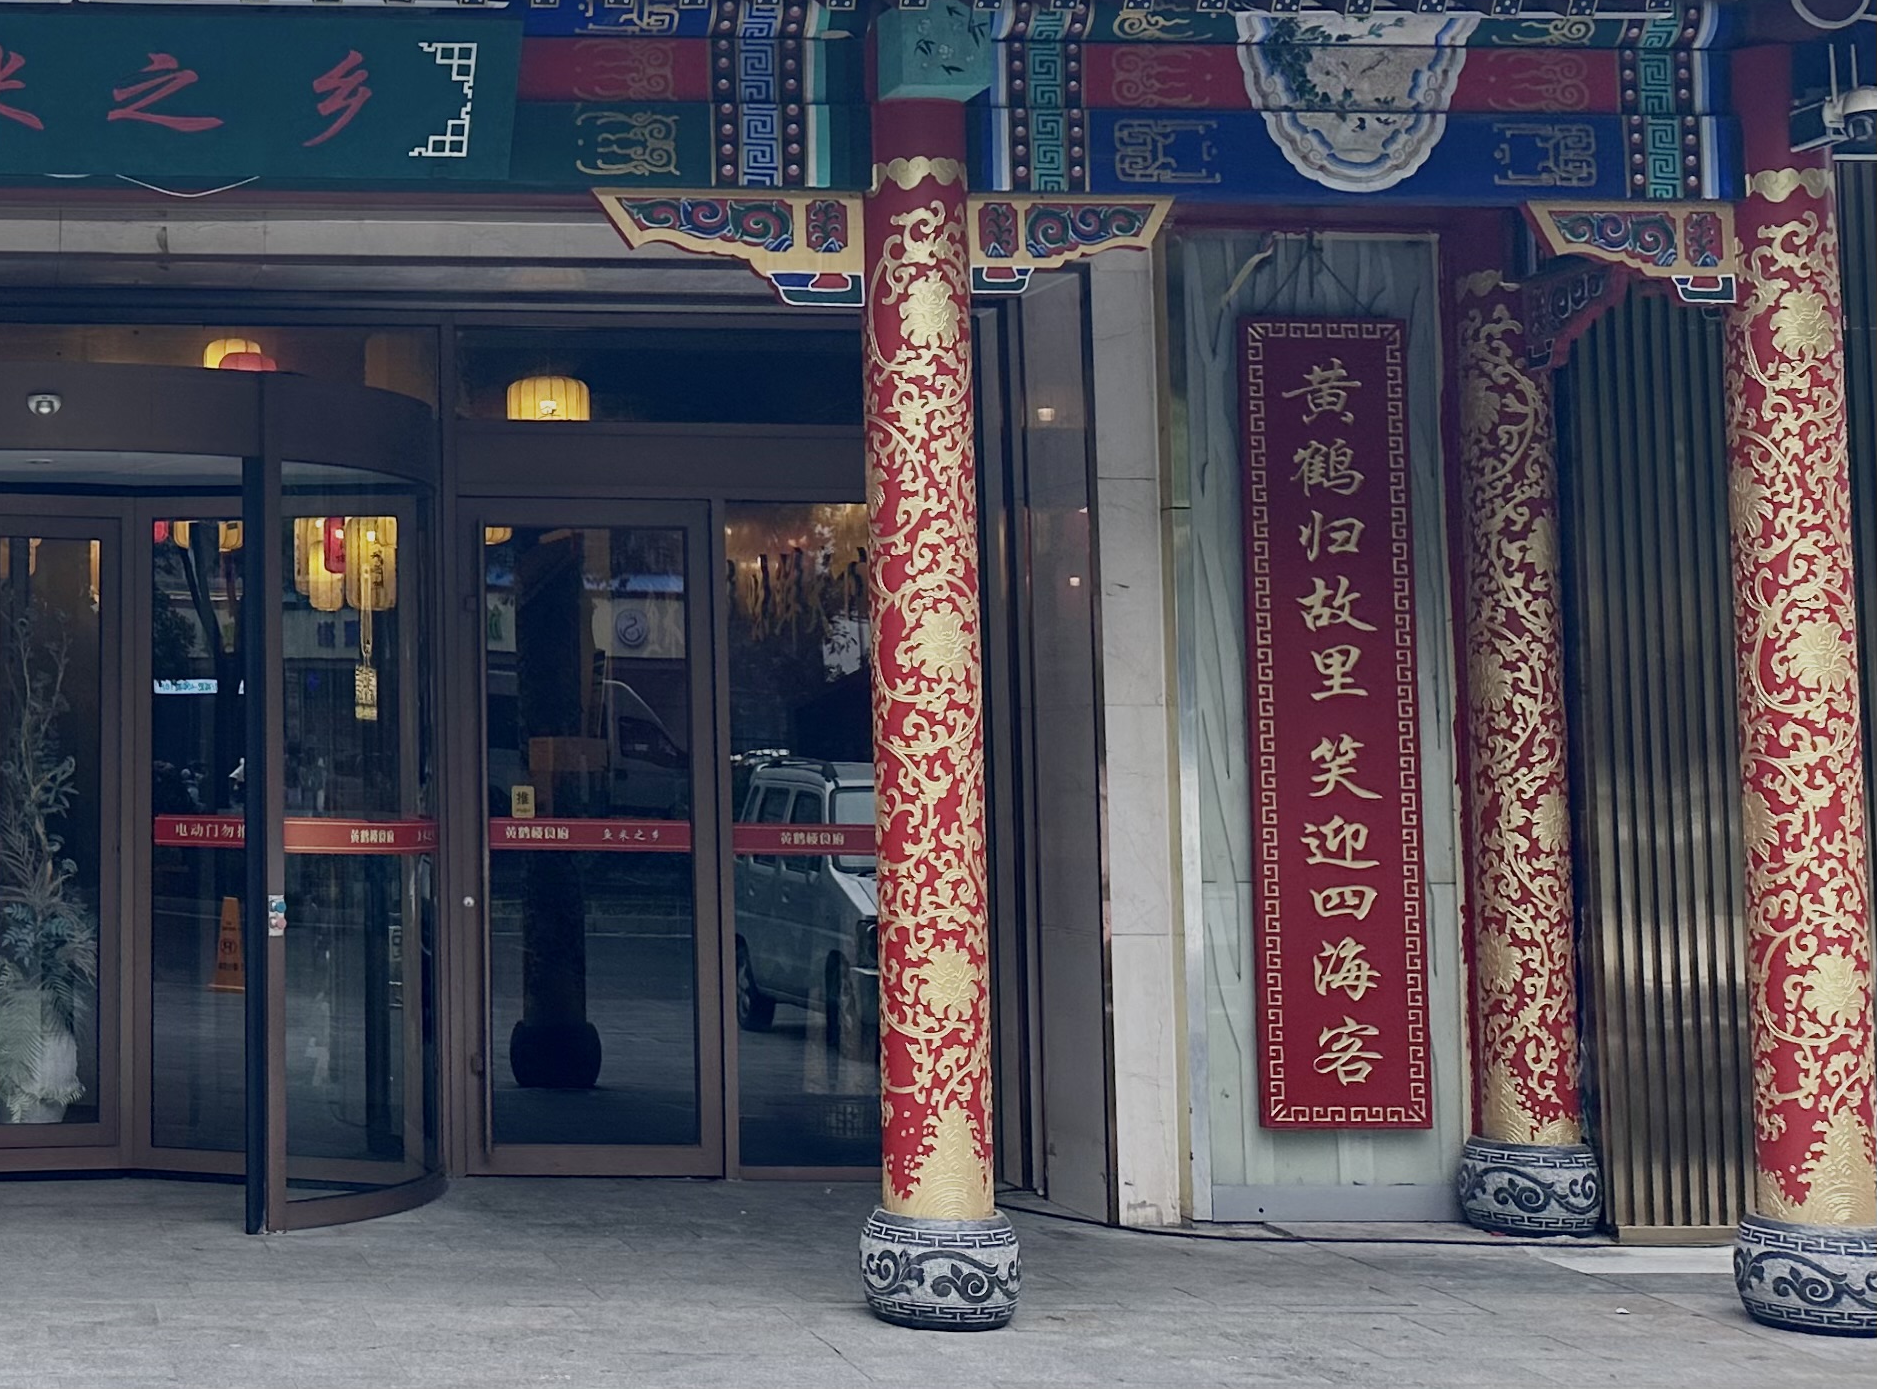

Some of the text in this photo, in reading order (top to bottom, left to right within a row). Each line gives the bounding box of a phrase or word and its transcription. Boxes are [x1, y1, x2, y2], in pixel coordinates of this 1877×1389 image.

[1281, 358, 1384, 1088] 黄鹤归故里 笑迎四海客
[515, 790, 531, 805] 推
[349, 828, 395, 844] 黄鹤楼食府
[504, 825, 662, 842] 黄鹤楼食府 鱼米之乡
[779, 830, 845, 846] 黄鹤楼食府
